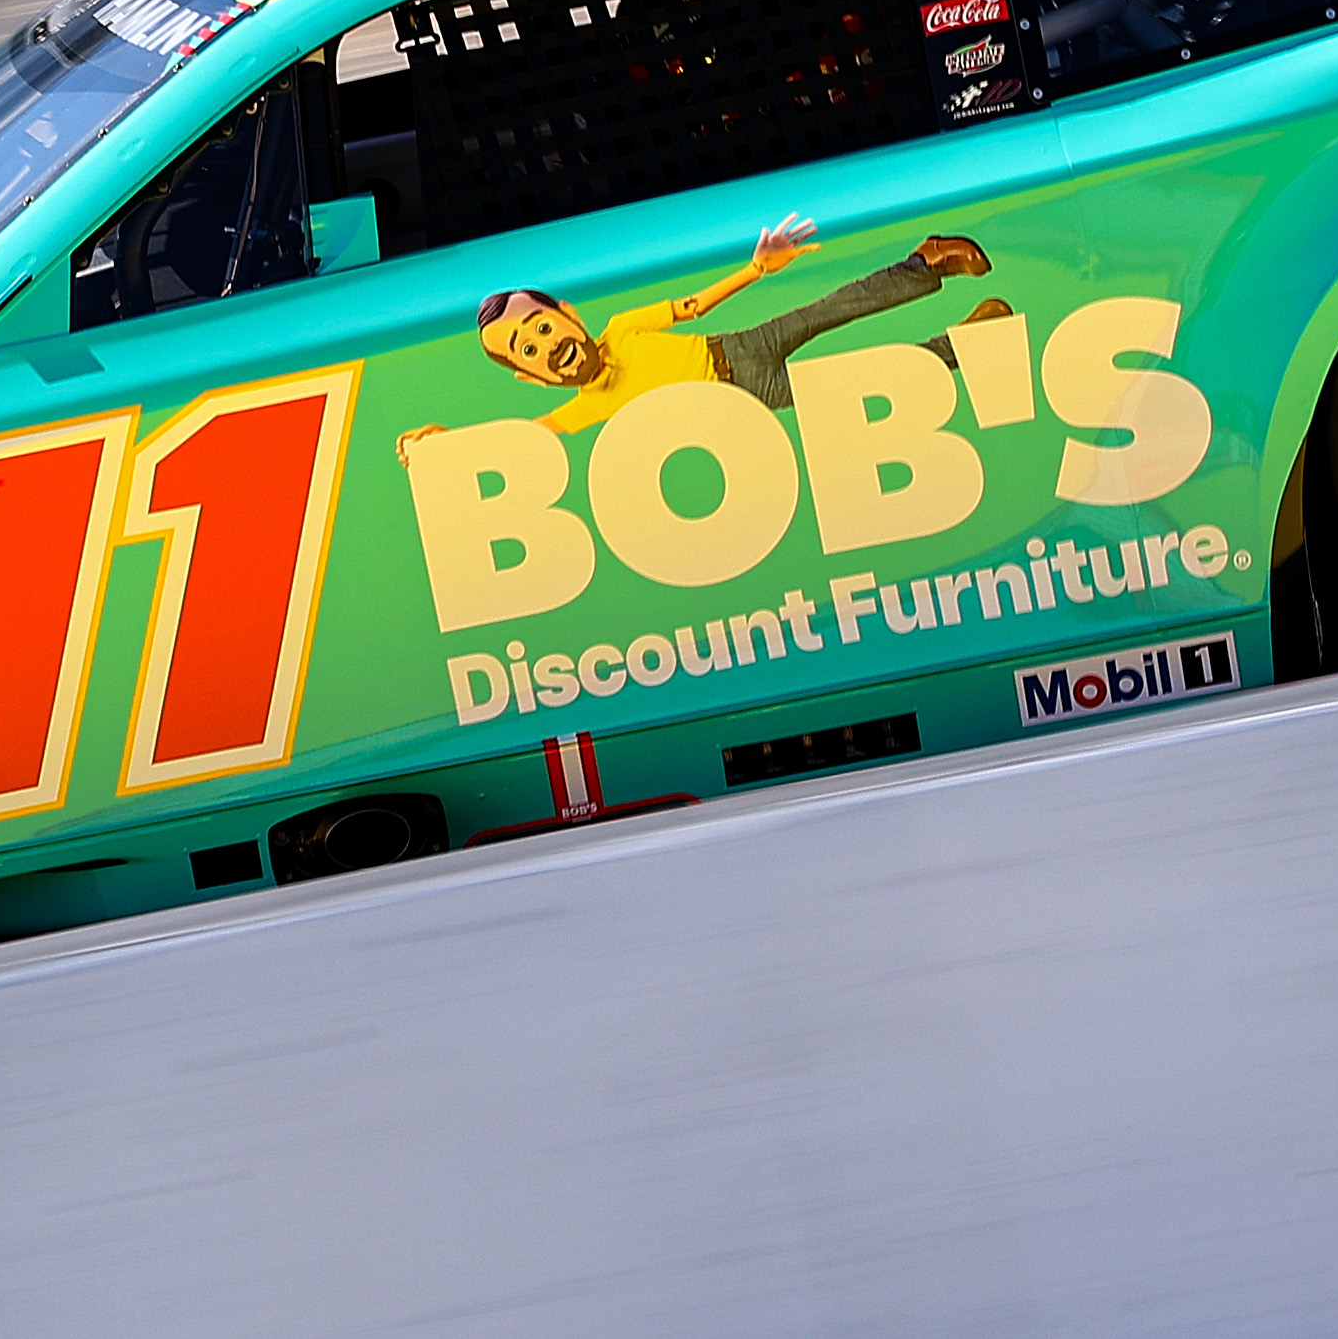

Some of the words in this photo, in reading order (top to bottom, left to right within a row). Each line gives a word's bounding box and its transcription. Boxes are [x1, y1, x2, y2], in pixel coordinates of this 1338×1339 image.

[407, 296, 1213, 635] BOB'S
[446, 588, 823, 727] Discount
[834, 523, 1231, 644] Furniture
[1021, 658, 1175, 722] Mobil
[1194, 644, 1215, 684] 1
